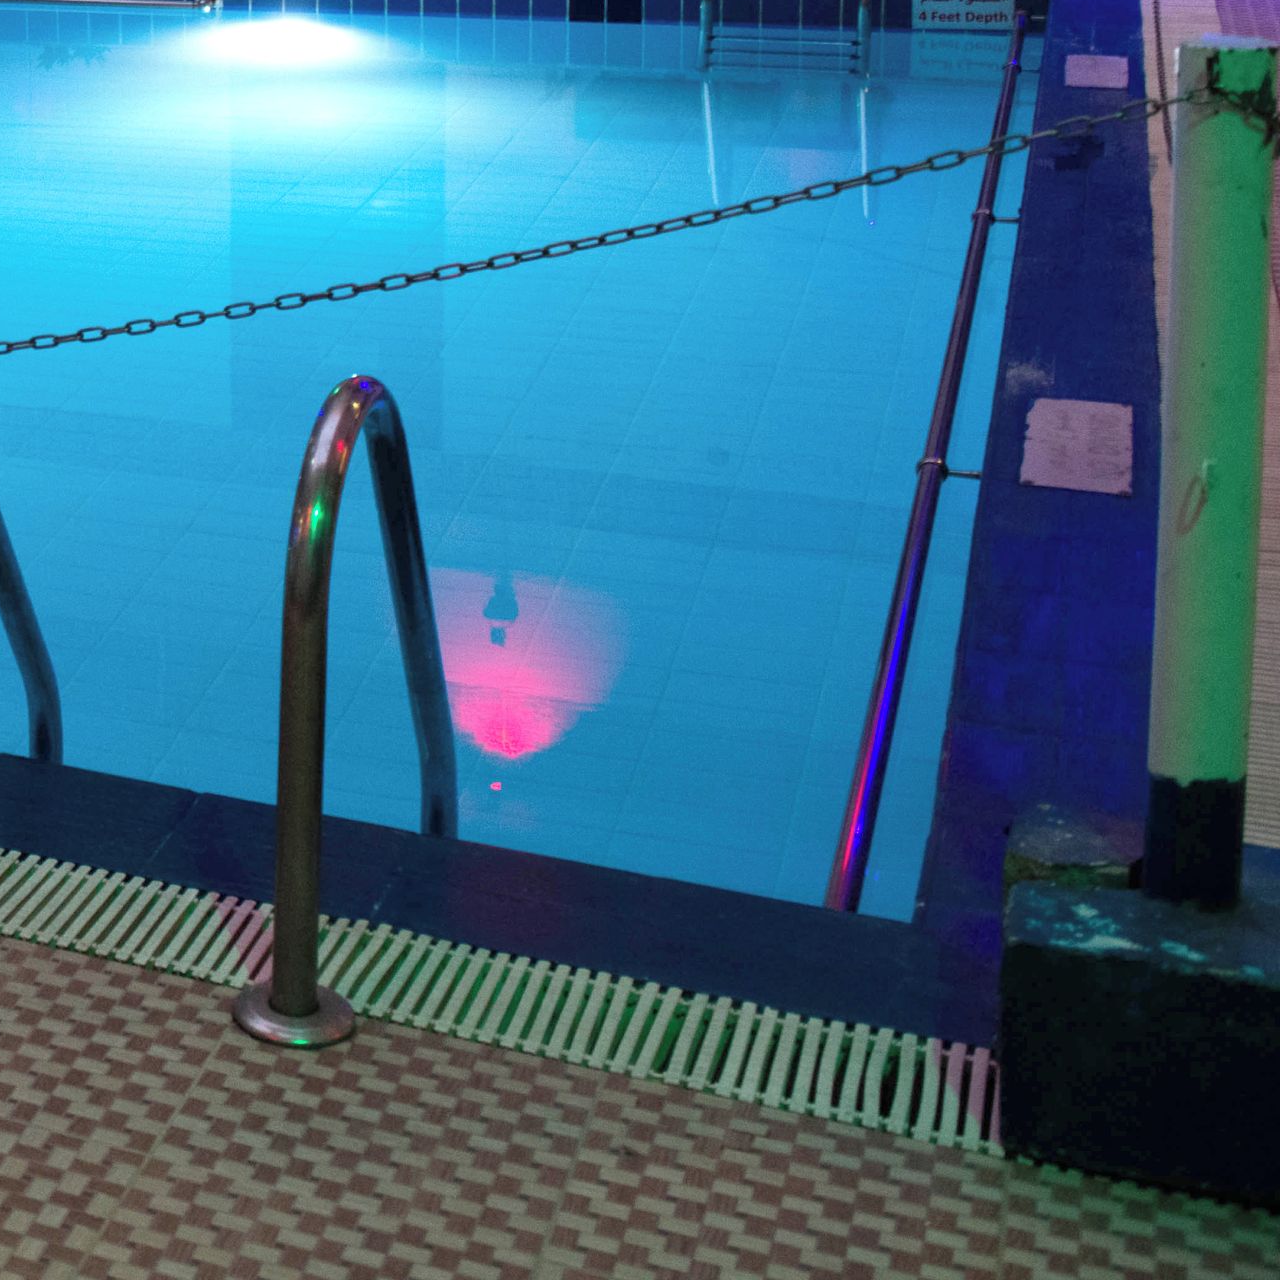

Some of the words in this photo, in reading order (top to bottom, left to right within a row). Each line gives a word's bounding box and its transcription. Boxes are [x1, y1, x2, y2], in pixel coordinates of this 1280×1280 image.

[918, 11, 927, 22] 4
[931, 11, 960, 22] Feet
[965, 11, 1009, 24] Depth
